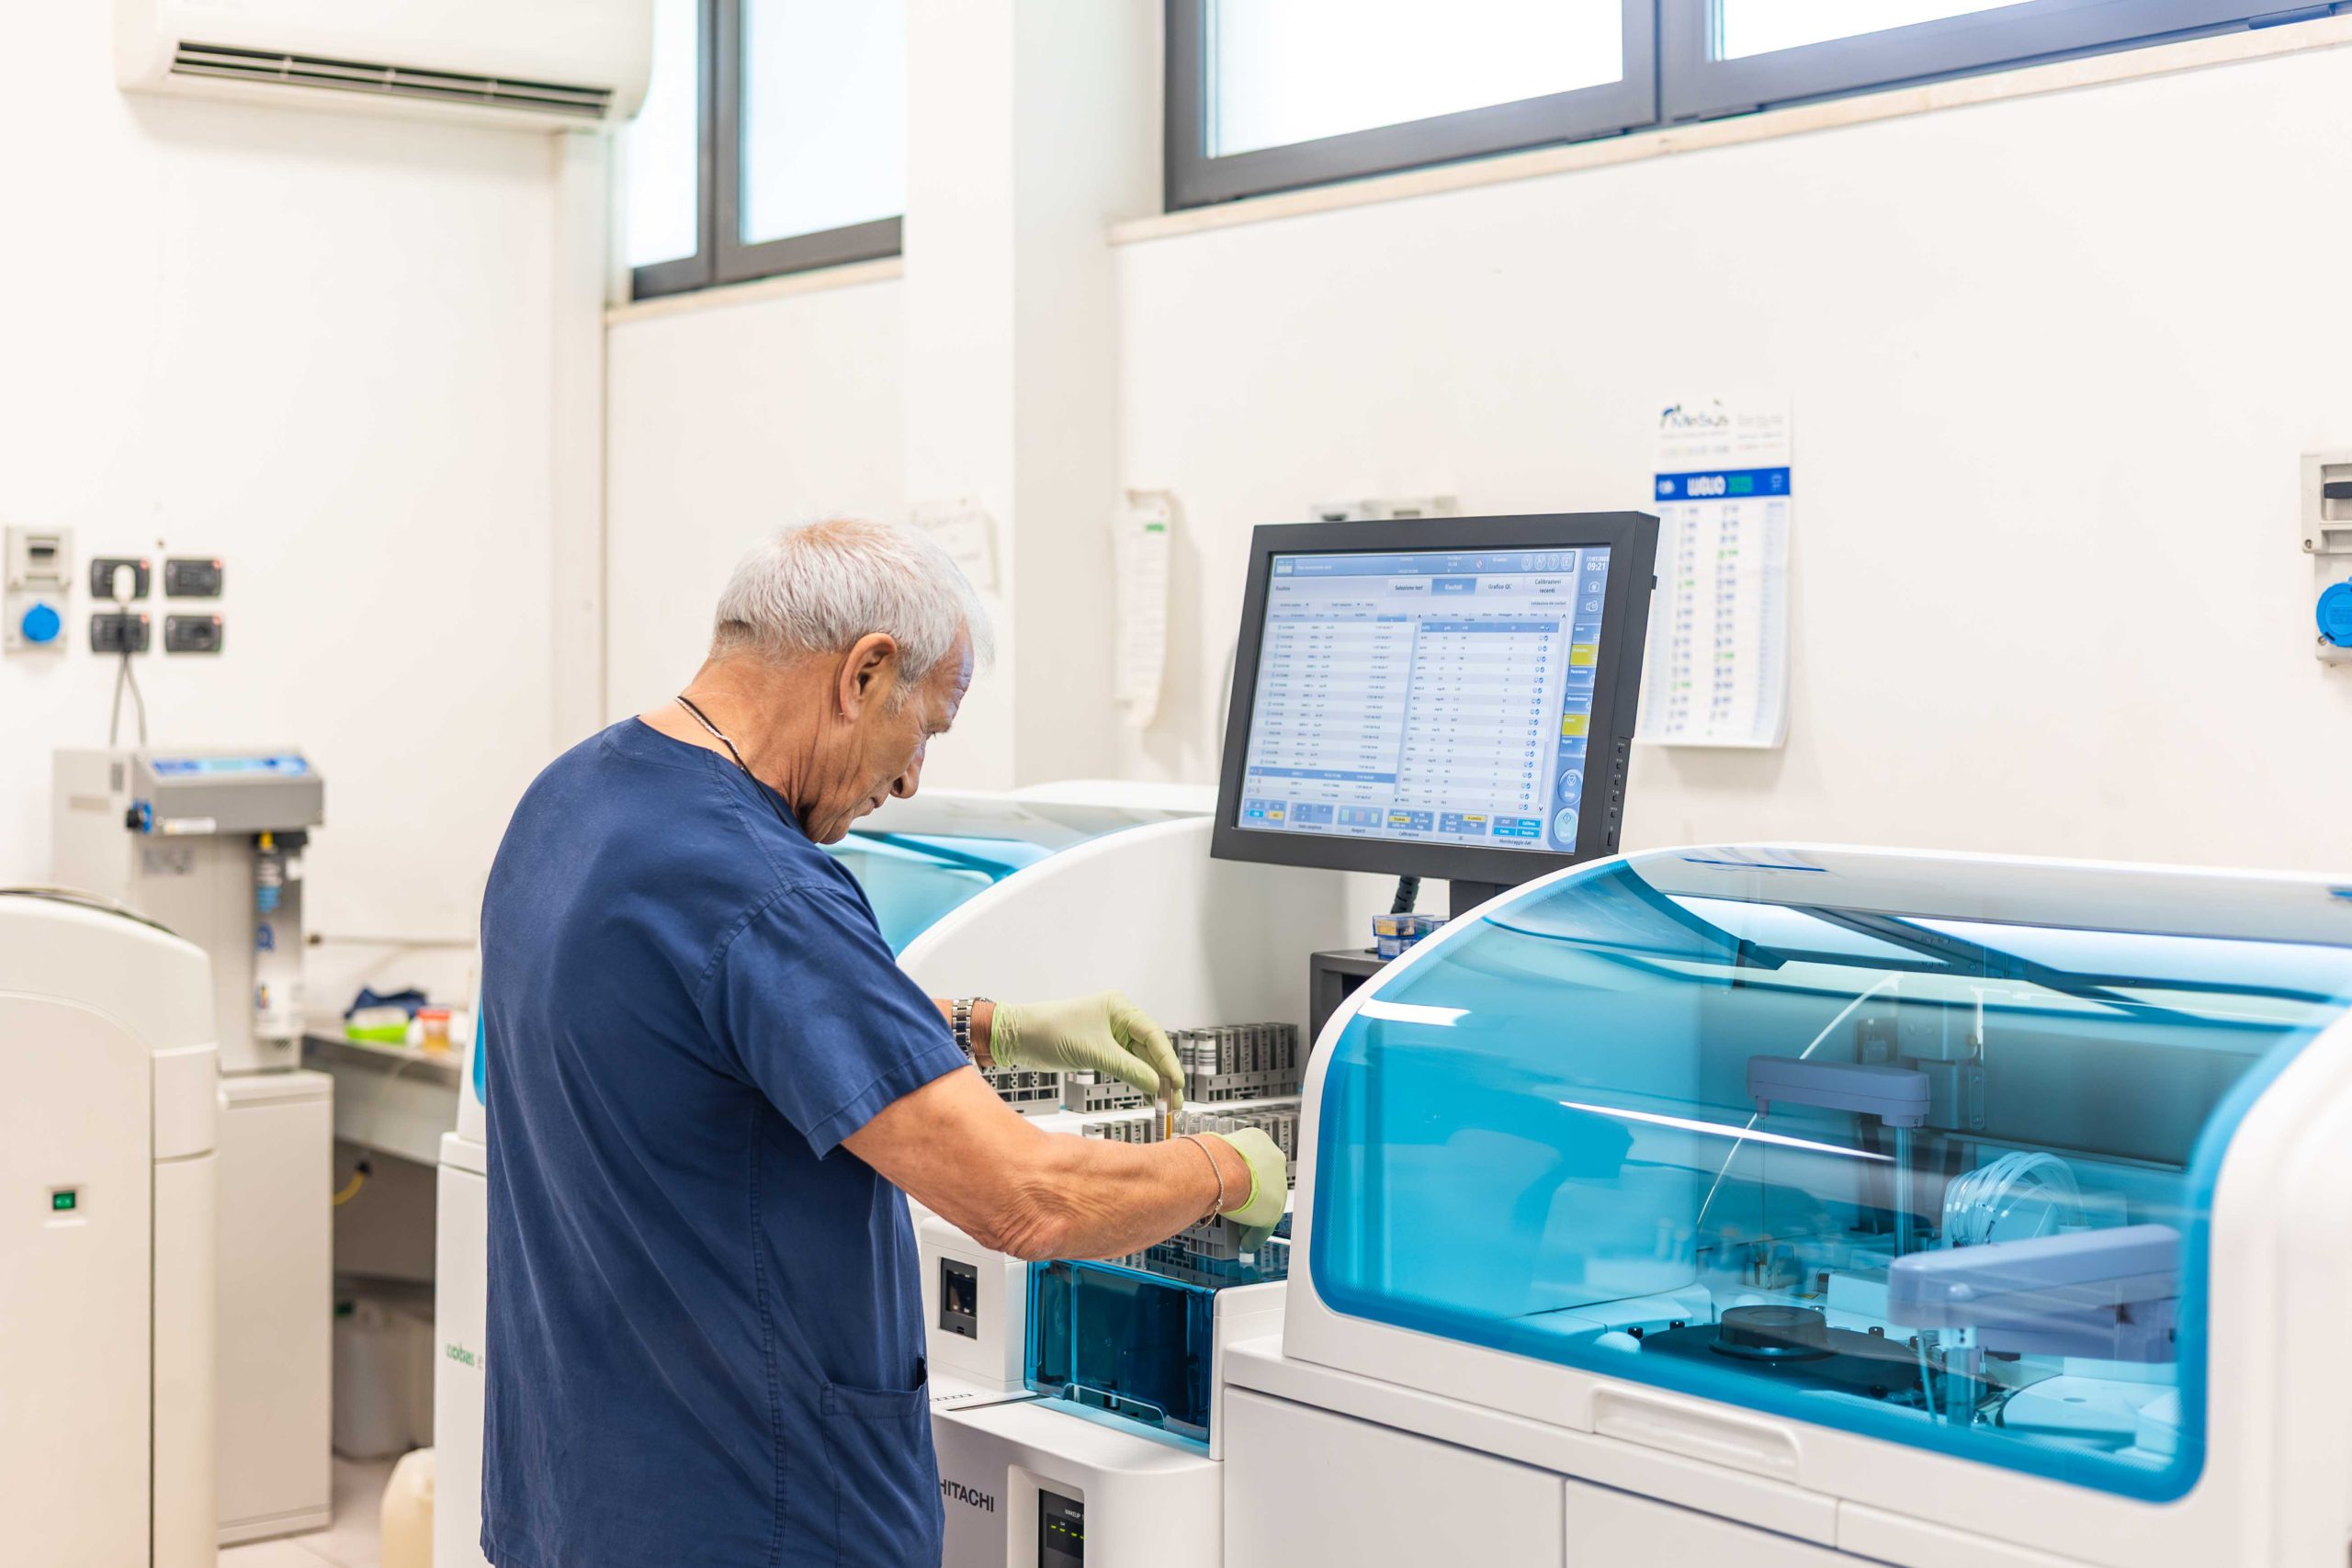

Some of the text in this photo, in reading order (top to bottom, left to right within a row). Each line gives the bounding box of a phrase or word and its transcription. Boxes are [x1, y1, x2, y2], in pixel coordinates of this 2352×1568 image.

[1587, 562, 1606, 570] 09:21
[446, 1342, 475, 1367] cobas
[941, 1479, 994, 1513] HITACHI
